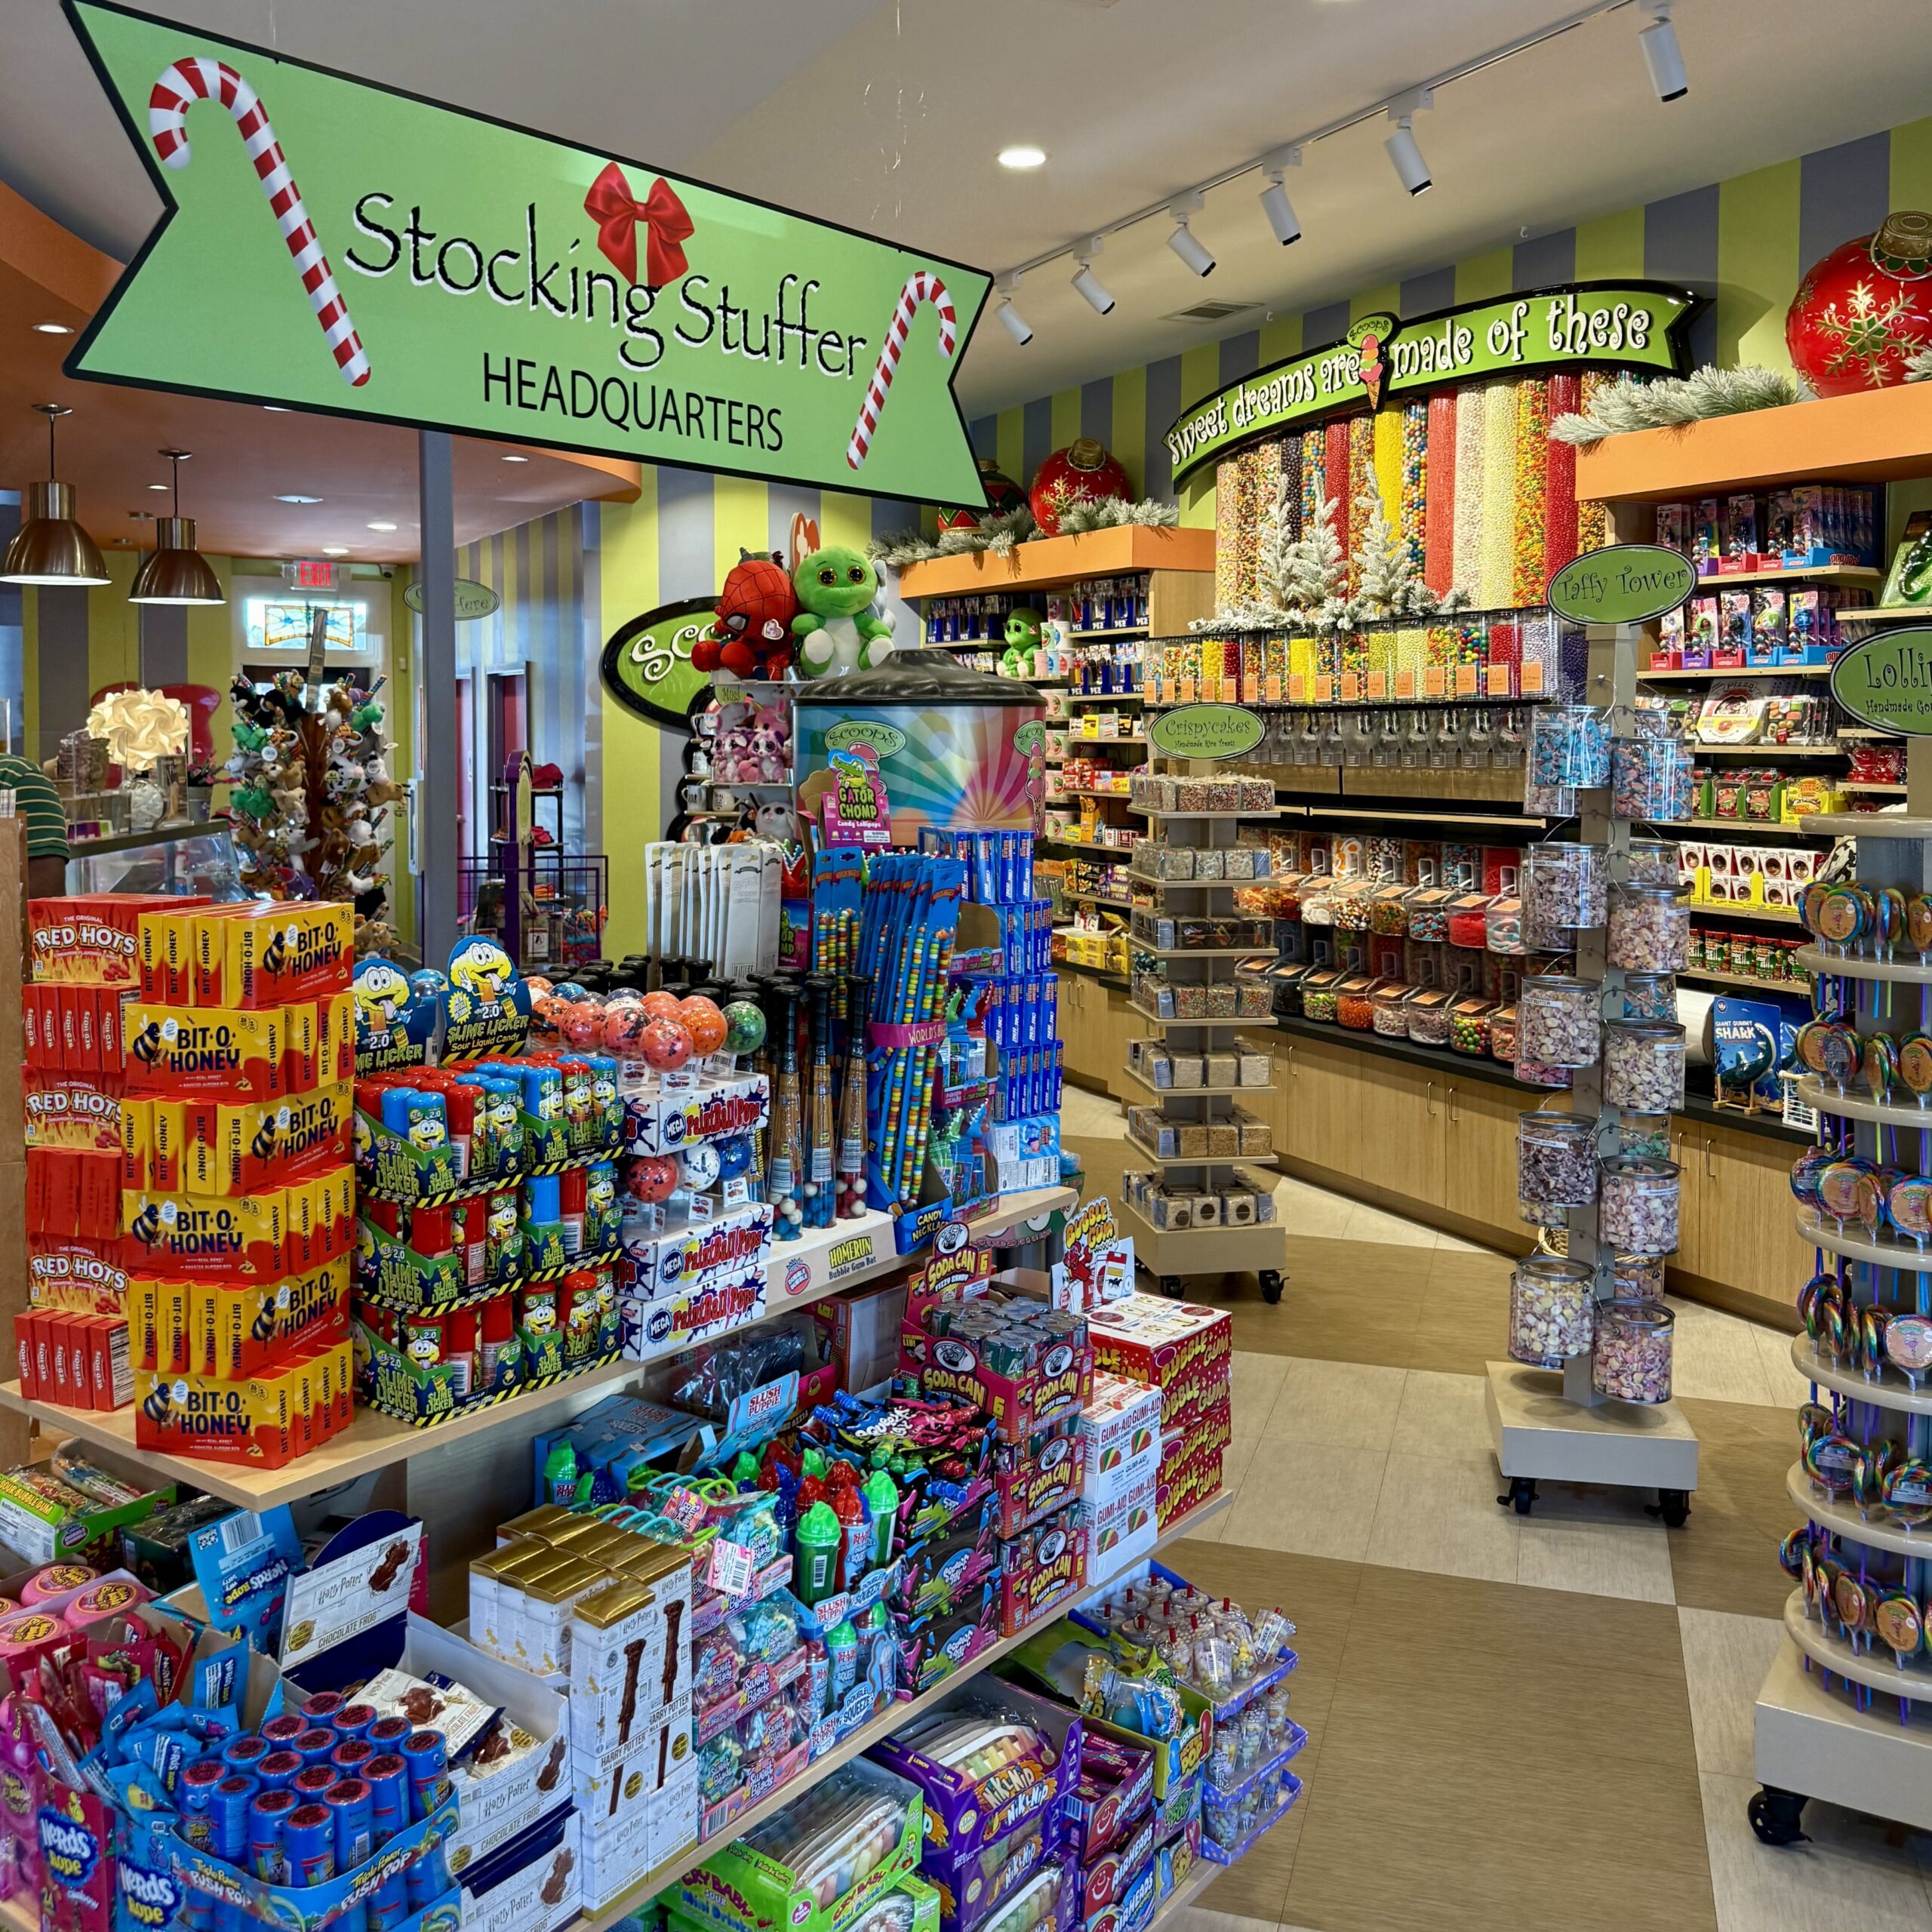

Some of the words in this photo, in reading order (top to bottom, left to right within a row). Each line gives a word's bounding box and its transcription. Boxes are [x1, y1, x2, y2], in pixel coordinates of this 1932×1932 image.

[345, 191, 665, 373] Stocking
[673, 273, 866, 380] Stuffer
[1392, 320, 1474, 380] made
[1487, 302, 1528, 361] of
[1547, 295, 1650, 355] these
[482, 352, 784, 452] HEADQUARTERS
[1167, 396, 1229, 466] sweet
[1233, 375, 1315, 426] dreams
[1320, 349, 1359, 394] are
[300, 562, 332, 586] EXIT
[1557, 574, 1609, 603] Taffy
[1615, 565, 1689, 596] Tower
[1072, 623, 1083, 632] PEZ
[1093, 621, 1105, 630] PEZ
[1115, 620, 1128, 628] PEZ
[1137, 617, 1149, 626] PEZ
[1866, 699, 1913, 715] Handmade
[1165, 715, 1251, 739] Crispycakes
[1174, 739, 1204, 748] Handmade
[838, 786, 875, 803] GATOR
[839, 803, 878, 820] CHOMP
[75, 915, 103, 924] ORIGINAL
[33, 924, 77, 953] RED
[78, 923, 139, 957] HOTS
[291, 941, 342, 977] HONEY
[482, 1004, 500, 1018] 2.0
[370, 1034, 389, 1050] 2.0
[447, 1022, 486, 1046] SLIME
[487, 1015, 530, 1036] LICKER
[451, 1041, 470, 1051] Sour
[472, 1037, 495, 1049] Liquid
[497, 1032, 520, 1044] Candy
[909, 1026, 937, 1044] WORLD'S
[1715, 1025, 1756, 1041] SHARK
[170, 1048, 242, 1073] HONEY
[71, 1082, 97, 1091] ORIGINAL
[27, 1091, 69, 1116] RED
[736, 1096, 761, 1128] Pops
[283, 1115, 339, 1160] HONEY
[666, 1116, 685, 1135] MEGA
[378, 1152, 416, 1174] SLIME
[376, 1169, 420, 1195] LICKER
[917, 1209, 943, 1226] CANDY
[1066, 1200, 1109, 1249] BUBBLE
[171, 1232, 244, 1254] HONEY
[736, 1227, 762, 1259] Pops
[1087, 1221, 1115, 1250] GUM
[829, 1236, 872, 1269] HOMERUN
[980, 1254, 988, 1271] 6
[32, 1256, 69, 1278] RED
[72, 1254, 130, 1293] HOTS
[380, 1258, 420, 1283] SLIME
[663, 1258, 682, 1277] MEGA
[829, 1266, 850, 1280] Bubble
[851, 1260, 866, 1271] Gum
[866, 1256, 876, 1266] Bat
[928, 1257, 955, 1292] SODA
[955, 1249, 975, 1273] CAN
[378, 1278, 423, 1306] LICKER
[729, 1284, 755, 1315] Pops
[283, 1288, 337, 1338] HONEY
[650, 1315, 671, 1336] MEGA
[1161, 1331, 1208, 1389] BUBBLE
[1204, 1333, 1229, 1367] GUM
[749, 1383, 781, 1407] SLUSH
[923, 1367, 955, 1392] SODA
[957, 1376, 986, 1412] CAN
[1034, 1383, 1059, 1414] SODA
[1059, 1372, 1078, 1395] CAN
[1161, 1375, 1201, 1425] UBBLE
[1198, 1379, 1227, 1414] GUM
[748, 1395, 781, 1418] PUPPIE
[993, 1395, 1005, 1415] 6
[180, 1414, 251, 1435] HONEY
[1101, 1414, 1133, 1443] GUMI-AID
[1132, 1396, 1161, 1422] GUMI-AID
[15, 1487, 37, 1508] BUBBLE
[36, 1499, 54, 1516] GUM
[1097, 1494, 1127, 1524] GUMI-AID
[1128, 1474, 1155, 1503] GUMI-AID
[1157, 1464, 1198, 1528] BUBBLE
[318, 1583, 340, 1605] Harry
[340, 1572, 363, 1595] Potter
[817, 1596, 846, 1615] SLUSH
[817, 1605, 846, 1623] PUPPIE
[318, 1619, 357, 1649] CHOCOLATE
[358, 1611, 377, 1629] FROG
[623, 1620, 636, 1635] Harry
[637, 1609, 652, 1625] Potter
[669, 1693, 690, 1713] POTTER
[846, 1686, 868, 1706] DOUBLE
[601, 1746, 623, 1767] HARRY
[623, 1734, 646, 1755] POTTER
[912, 1757, 930, 1769] LEMON
[485, 1794, 507, 1817] Harry
[509, 1779, 531, 1804] Potter
[1112, 1760, 1155, 1826] AIRHEADS
[480, 1820, 519, 1852] CHOCOLATE
[520, 1804, 541, 1828] FROG
[1112, 1822, 1154, 1888] AIRHEADS
[190, 1870, 223, 1897] PUSH
[681, 1866, 711, 1887] CRY
[710, 1873, 755, 1918] BABY
[857, 1869, 888, 1896] BABY
[681, 1890, 710, 1914] Mini
[703, 1888, 728, 1907] SOUR
[1114, 1871, 1154, 1932] AIRHEADS
